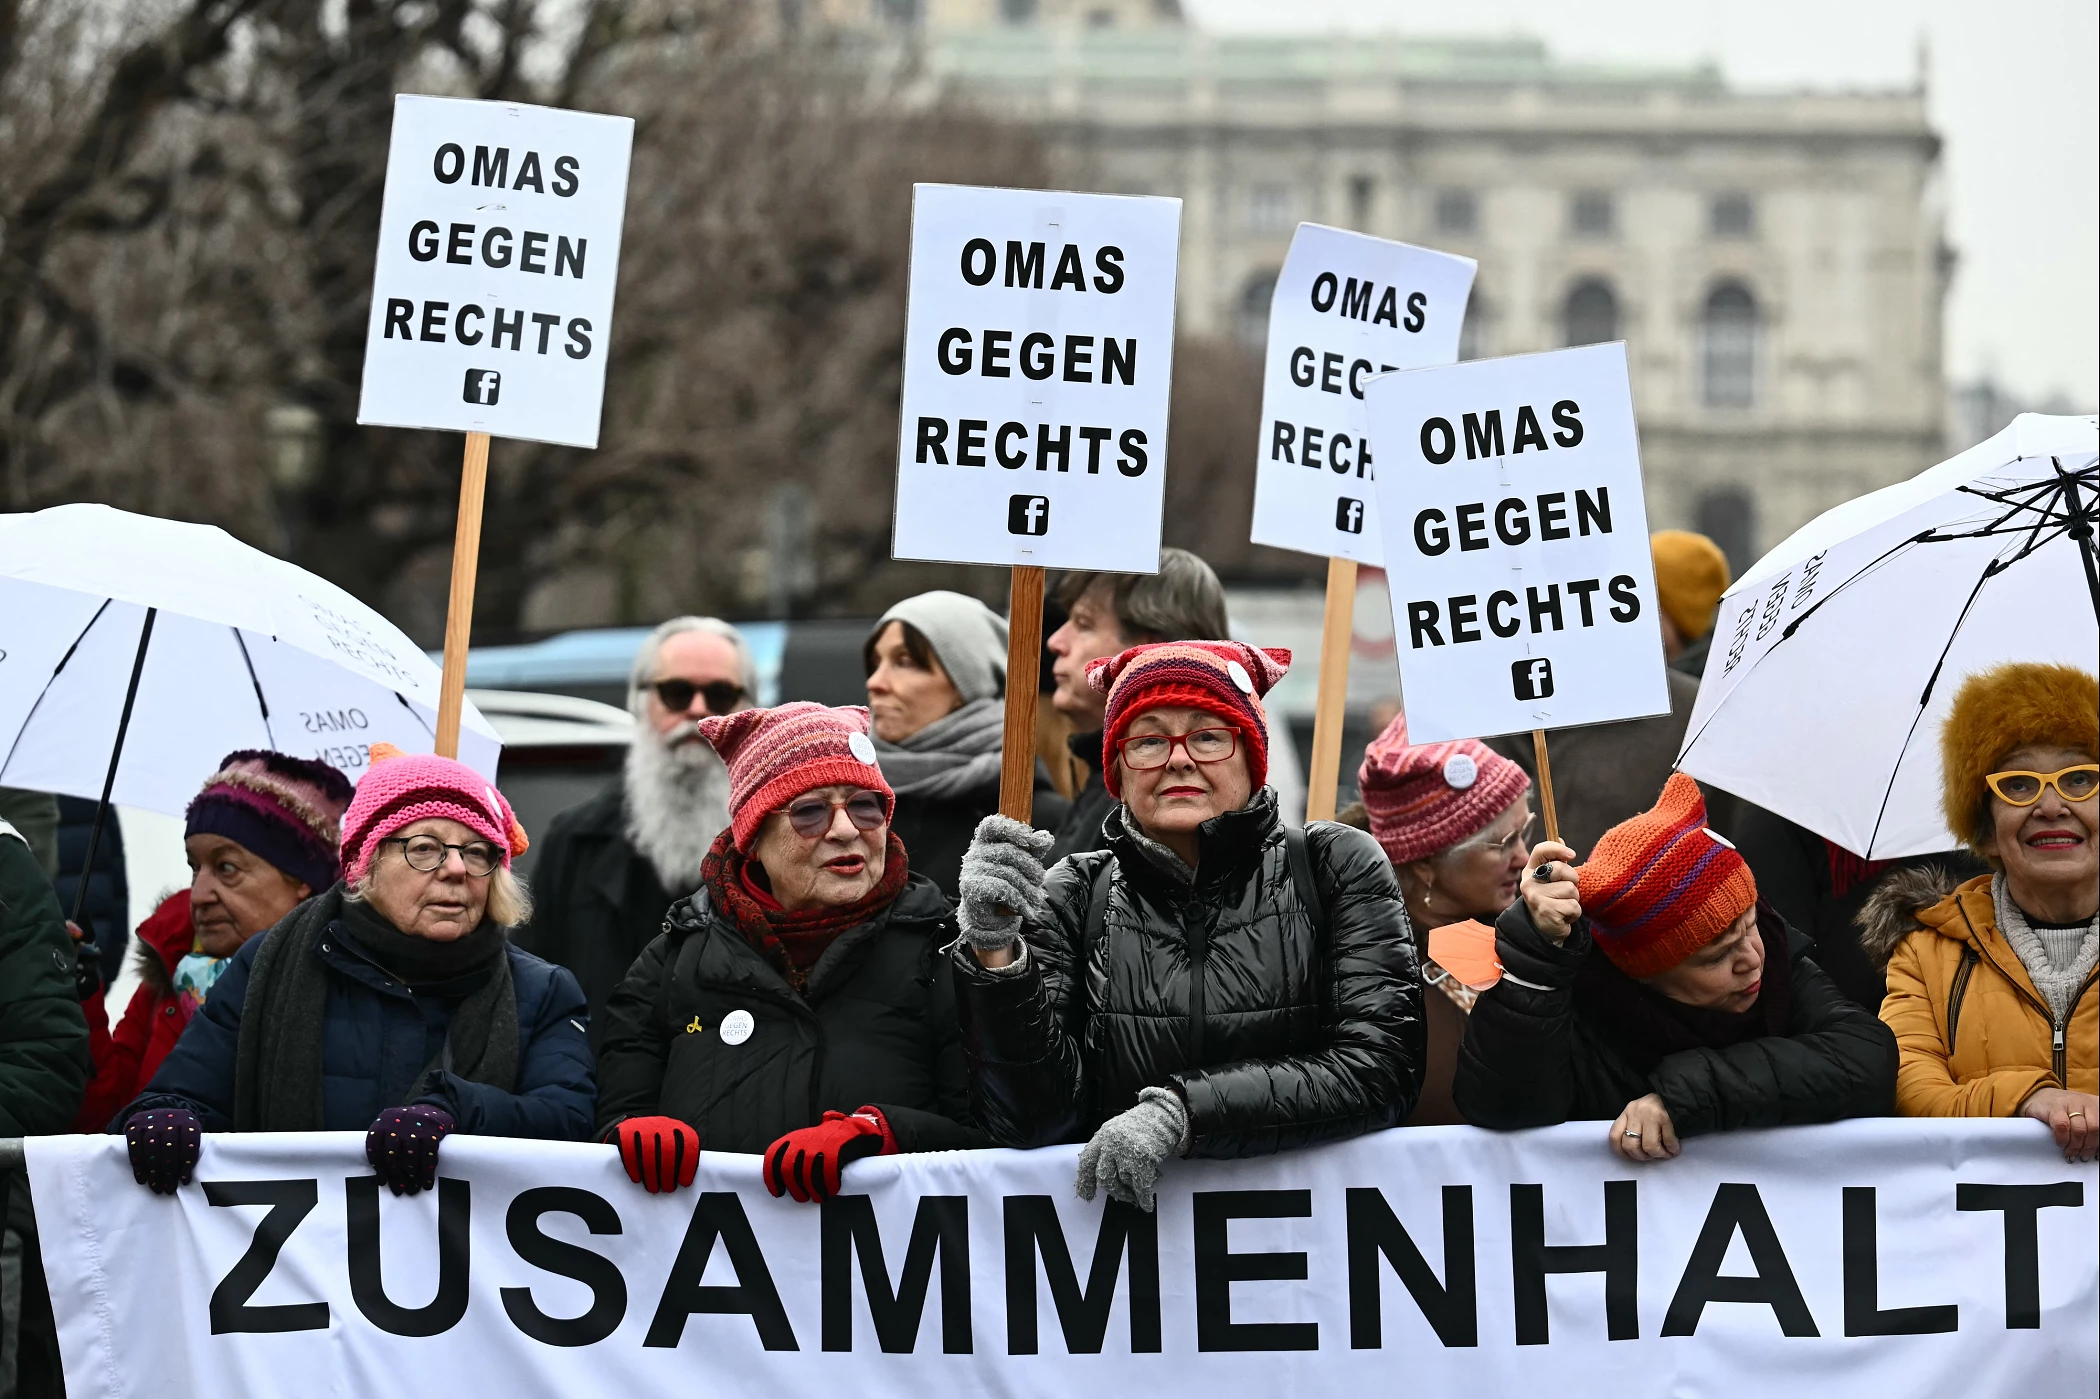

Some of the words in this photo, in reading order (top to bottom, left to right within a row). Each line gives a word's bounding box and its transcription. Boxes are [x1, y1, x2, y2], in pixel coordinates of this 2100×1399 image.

[433, 142, 580, 198] OMAS
[408, 220, 587, 280] GEGEN
[960, 237, 1125, 295] OMAS
[383, 297, 593, 360] RECHTS
[1311, 271, 1427, 334] OMAS
[937, 327, 1137, 386] GEGEN
[915, 416, 1148, 478] RECHTS
[1271, 420, 1374, 480] RECH
[1420, 399, 1584, 465] OMAS
[1413, 486, 1613, 557] GEGEN
[1407, 574, 1641, 650] RECHTS
[326, 633, 419, 688] RECHTS
[721, 1029, 748, 1037] RECHTS
[724, 1021, 748, 1029] GEGEN
[201, 1176, 2084, 1355] ZUSAMMENHALT
